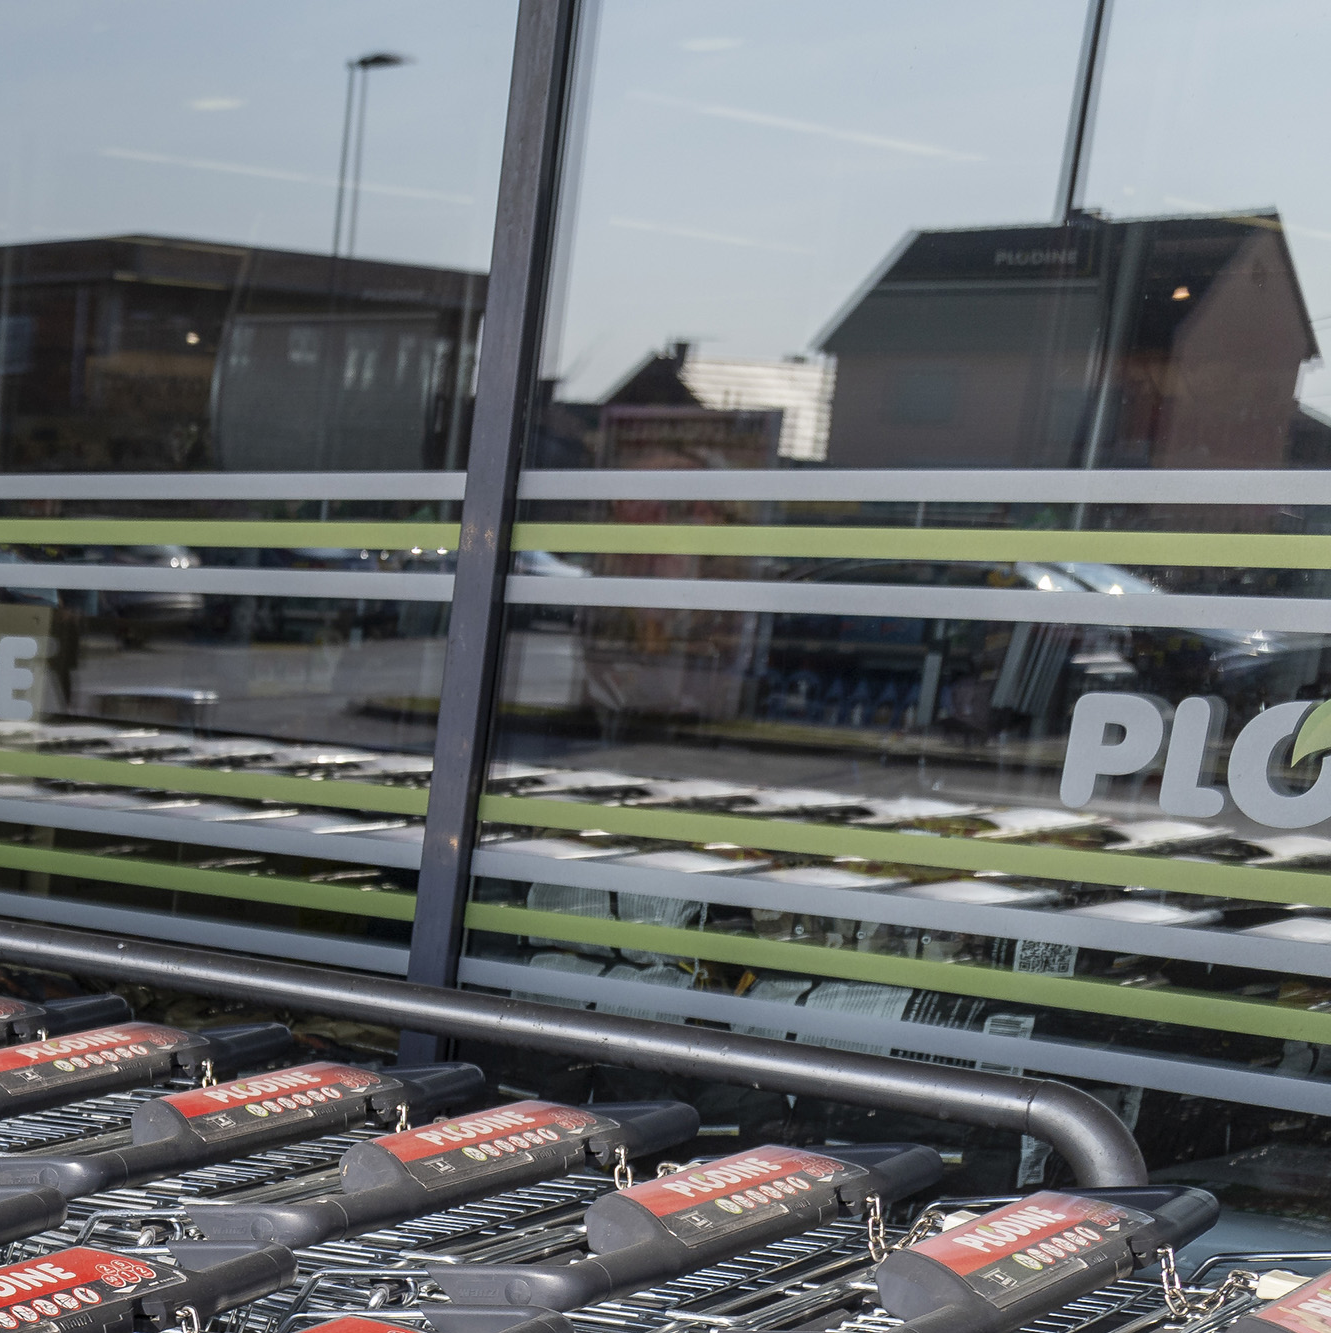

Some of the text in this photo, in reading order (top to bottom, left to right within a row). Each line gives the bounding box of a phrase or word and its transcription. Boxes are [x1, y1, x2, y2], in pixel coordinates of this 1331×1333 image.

[15, 1031, 133, 1060] PLODINE
[215, 1071, 322, 1103] PLODINE
[414, 1110, 536, 1147] PLODINE
[661, 1157, 782, 1197] PLODINE
[952, 1205, 1067, 1253] PLODINE
